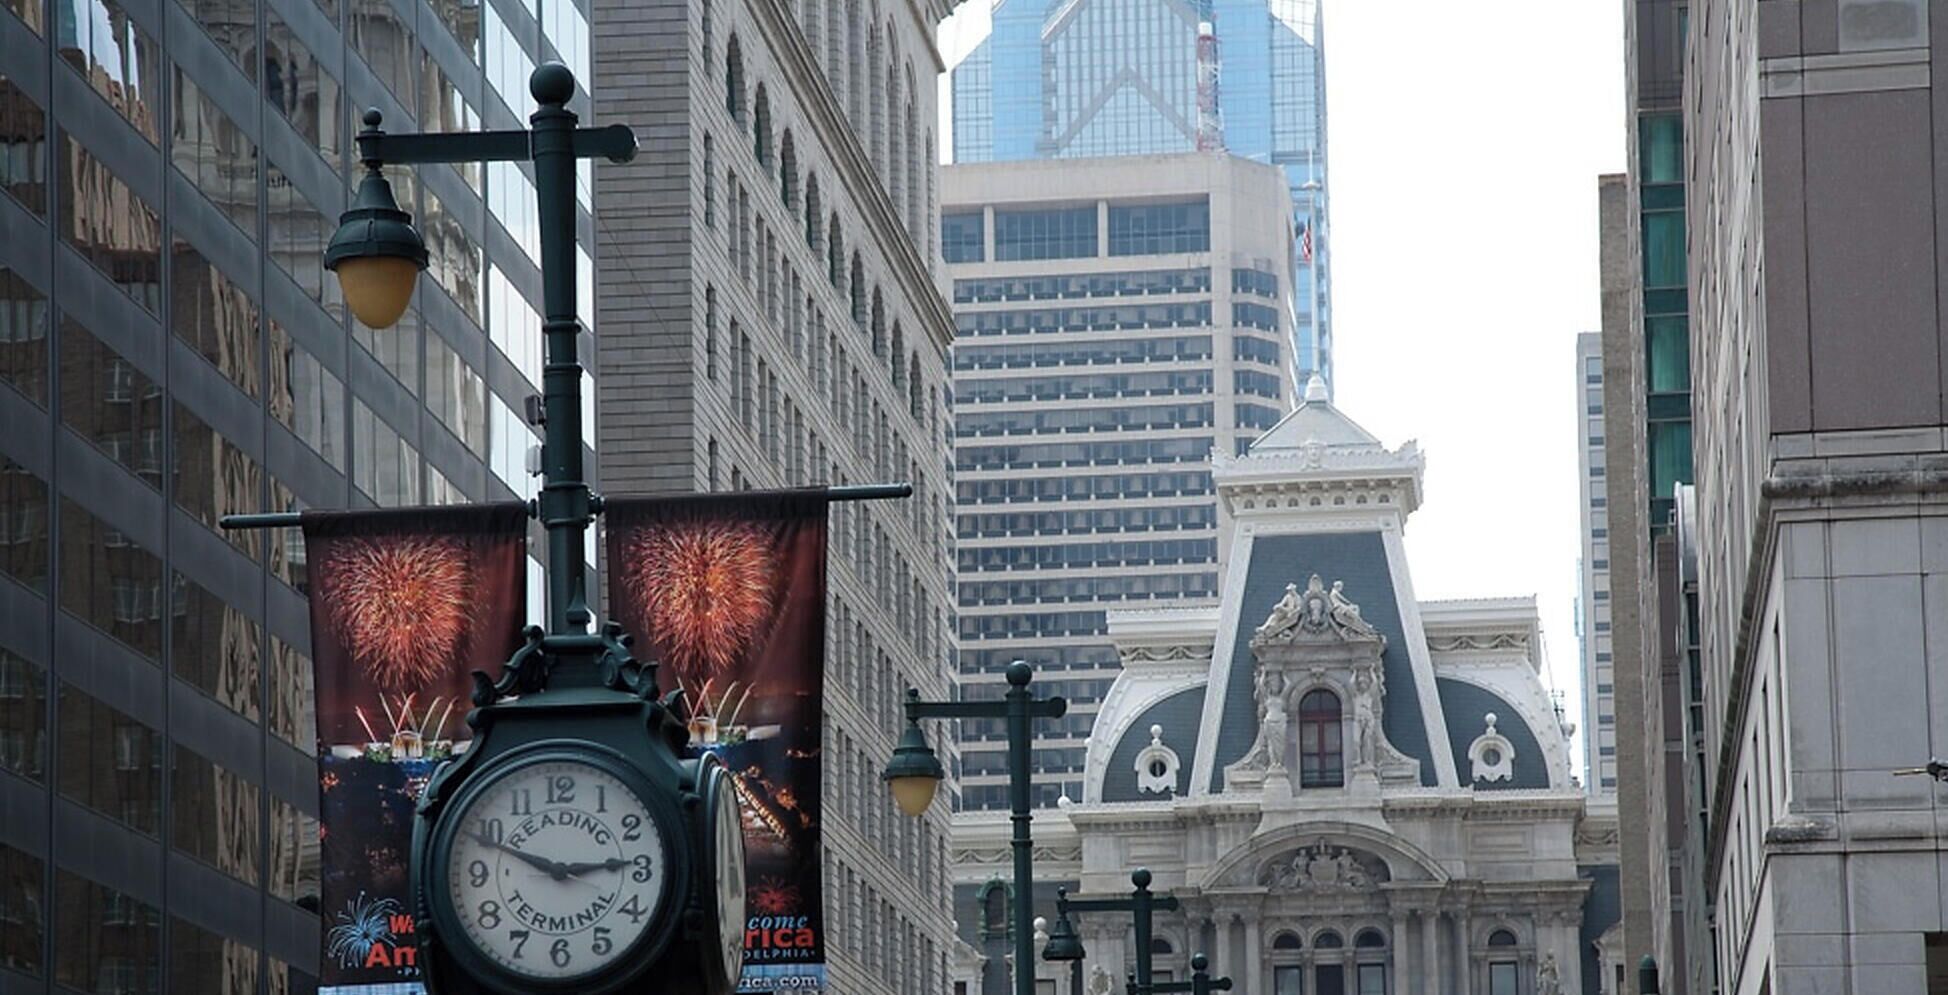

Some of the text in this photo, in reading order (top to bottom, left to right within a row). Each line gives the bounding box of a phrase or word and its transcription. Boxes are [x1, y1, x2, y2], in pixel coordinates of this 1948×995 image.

[510, 789, 532, 816] 11
[545, 776, 575, 804] 12
[596, 785, 608, 813] 1
[480, 818, 503, 846] 10
[510, 811, 611, 850] READING
[621, 814, 641, 842] 2
[468, 860, 489, 888] 9
[632, 854, 653, 883] 3
[478, 900, 501, 930] 8
[507, 889, 615, 932] TERMINAL
[617, 894, 649, 924] 4
[747, 916, 808, 930] come
[509, 930, 531, 959] 7
[591, 927, 613, 956] 5
[745, 928, 815, 949] rica
[550, 939, 571, 968] 6
